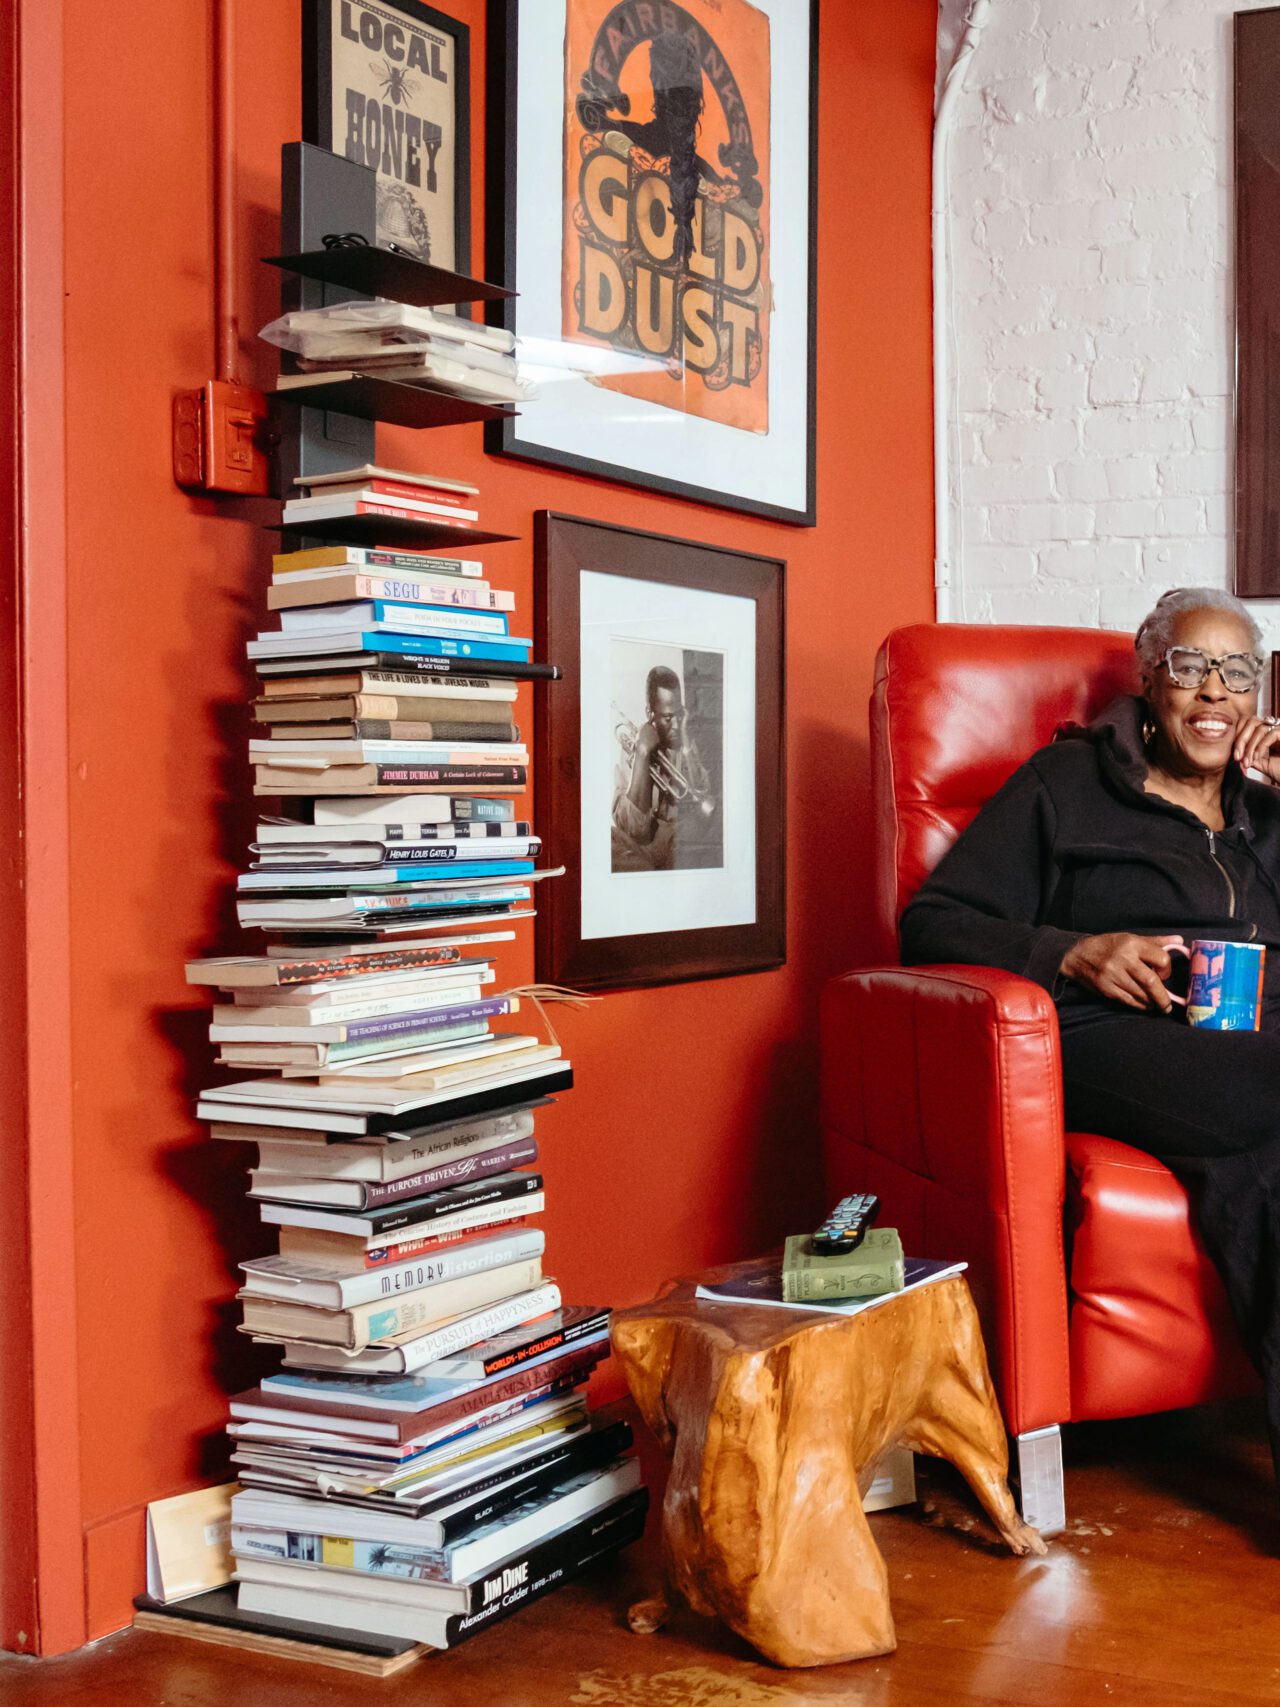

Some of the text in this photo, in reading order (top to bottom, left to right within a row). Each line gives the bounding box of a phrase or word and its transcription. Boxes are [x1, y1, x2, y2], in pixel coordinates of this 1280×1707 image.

[341, 0, 448, 84] LOCAL
[345, 88, 442, 194] HONEY
[582, 152, 760, 293] GOLD
[582, 243, 759, 384] DUST
[383, 580, 421, 600] SEGU
[368, 672, 381, 681] THE
[381, 673, 395, 682] LIFE
[401, 675, 420, 684] LOVES
[382, 770, 409, 780] JIMMIE
[409, 770, 439, 780] DURHAM
[389, 849, 410, 859] HENRY
[411, 849, 428, 859] LOUIS
[411, 1133, 480, 1160] The African Religions
[371, 1188, 386, 1197] THE
[387, 1177, 423, 1194] PURPOSE
[424, 1168, 454, 1183] DRIVEN
[481, 1154, 506, 1167] WARREN
[398, 1237, 424, 1254] WHAT
[381, 1262, 444, 1294] MEMORY
[428, 1323, 474, 1351] PURSUIT
[484, 1294, 544, 1327] HAPPYNESS
[474, 1506, 493, 1521] BLACK
[482, 1561, 529, 1606] JIM DINE
[458, 1601, 500, 1632] Alexander
[502, 1586, 529, 1607] Calder
